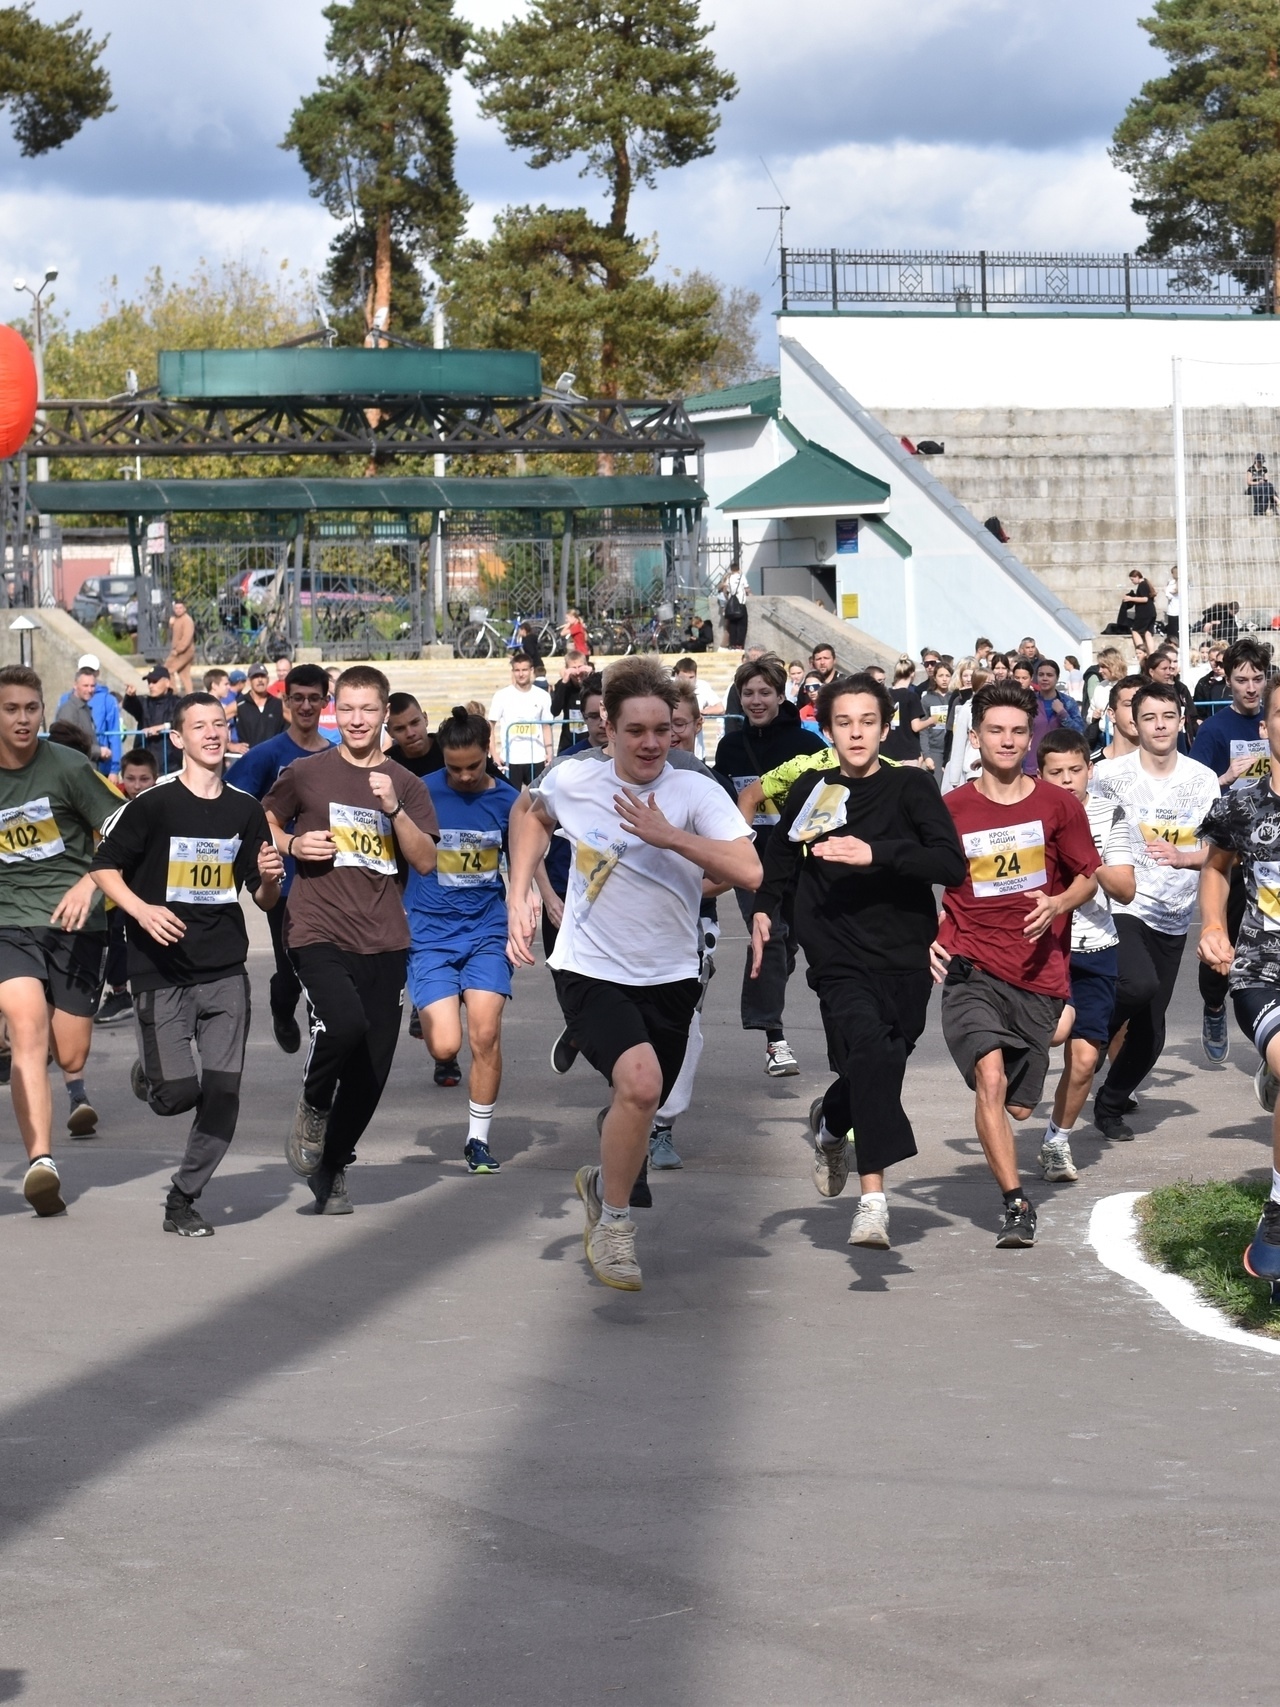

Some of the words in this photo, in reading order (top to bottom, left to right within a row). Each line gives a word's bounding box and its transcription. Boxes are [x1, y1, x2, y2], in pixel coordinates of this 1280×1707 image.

[515, 725, 530, 734] 707
[1245, 758, 1271, 777] 245
[353, 810, 373, 818] КРОСС
[5, 825, 41, 849] 102
[988, 830, 1009, 839] КРОСС
[989, 835, 1016, 845] НАЦИИ
[351, 831, 383, 857] 103
[992, 842, 1018, 852] 2024
[460, 852, 482, 872] 74
[993, 852, 1021, 878] 24
[190, 864, 221, 887] 101
[992, 876, 1028, 887] ИВАНОВСКАЯ
[999, 884, 1024, 893] ОБЛАСТЬ
